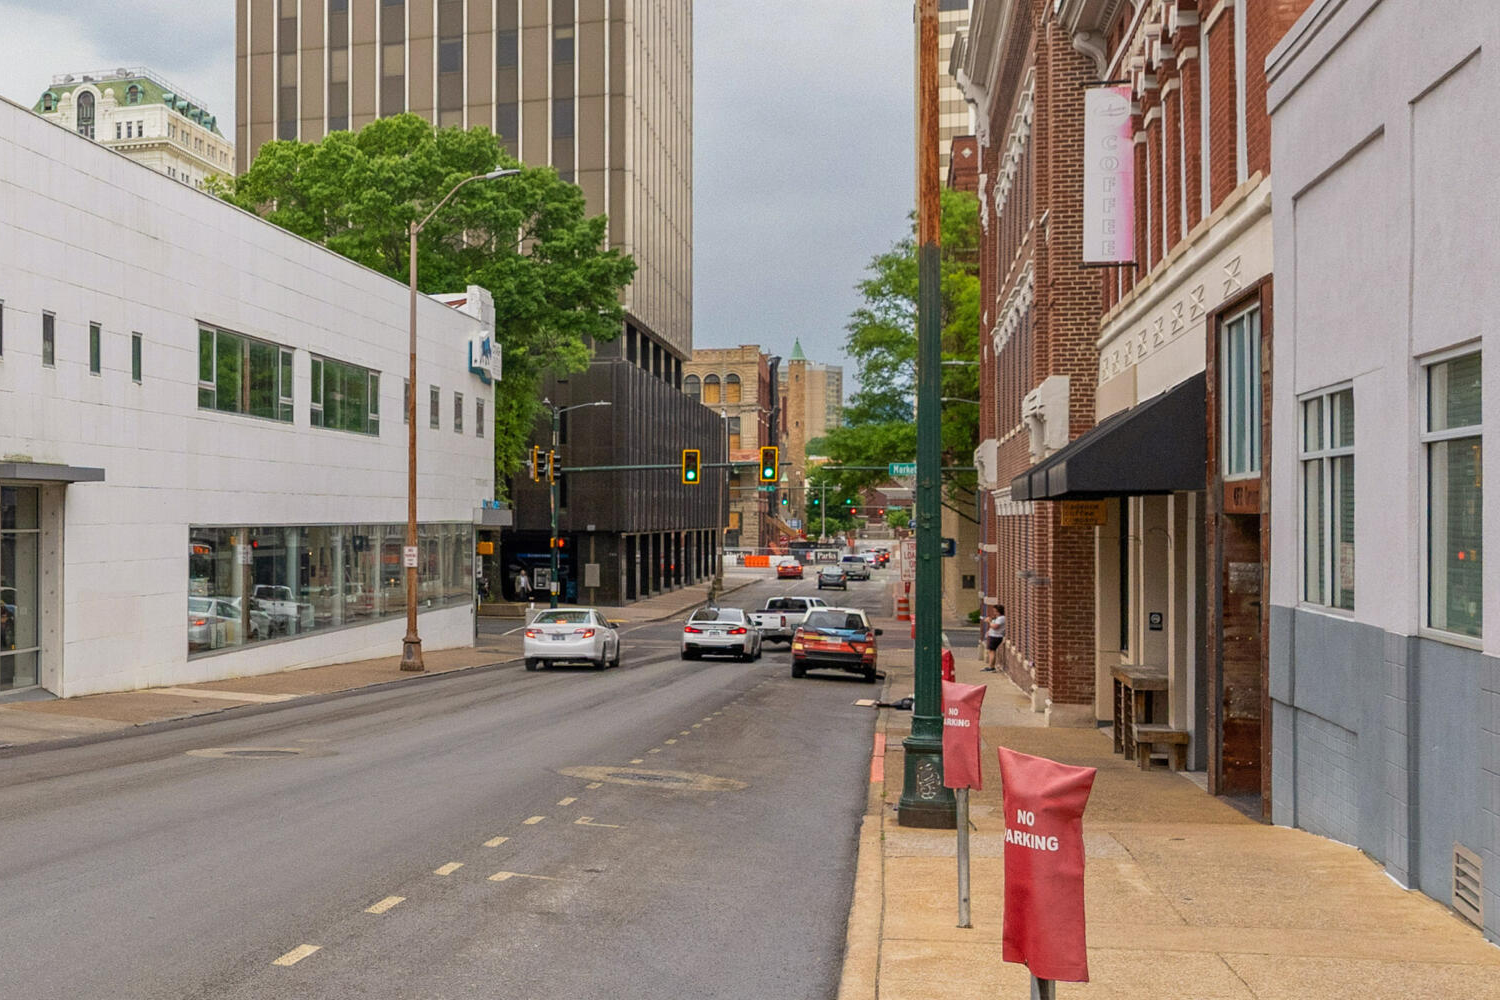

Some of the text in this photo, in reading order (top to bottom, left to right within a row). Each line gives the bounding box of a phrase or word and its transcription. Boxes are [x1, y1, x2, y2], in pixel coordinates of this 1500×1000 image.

[1100, 134, 1119, 257] COFFEE
[893, 464, 917, 474] Market
[948, 707, 959, 716] NO
[943, 717, 971, 728] ARKING
[1016, 808, 1035, 827] NO
[1004, 828, 1059, 852] ARKING
